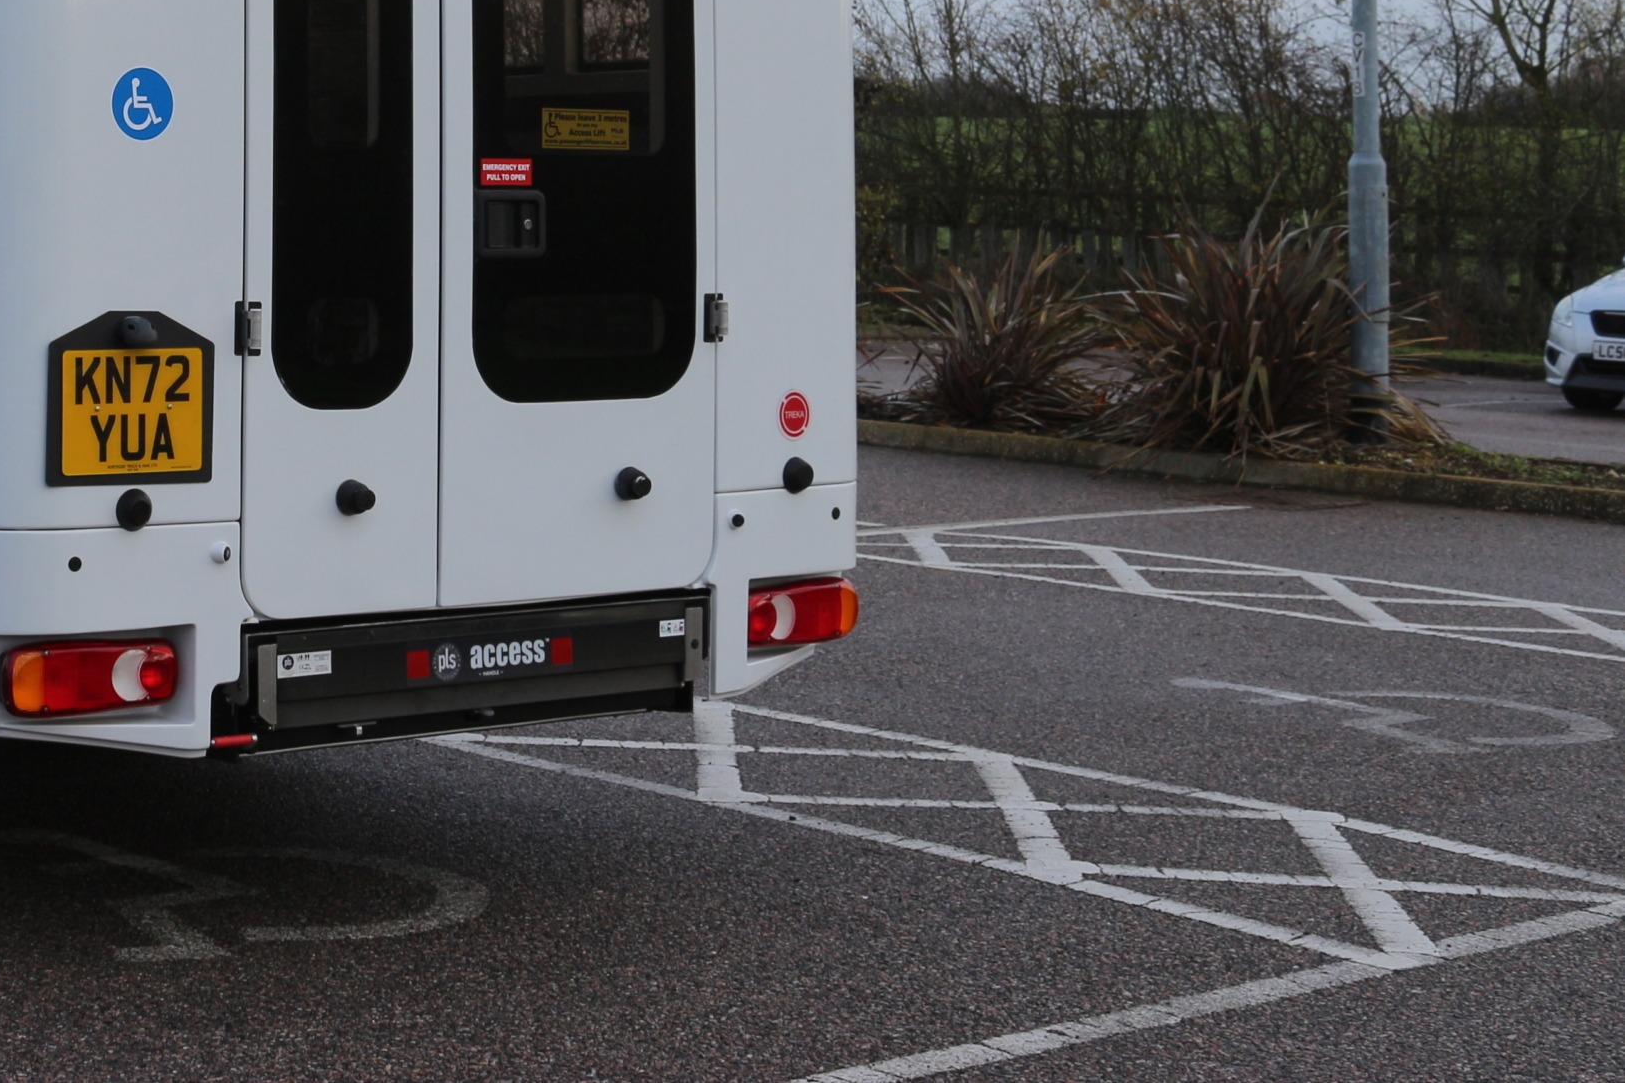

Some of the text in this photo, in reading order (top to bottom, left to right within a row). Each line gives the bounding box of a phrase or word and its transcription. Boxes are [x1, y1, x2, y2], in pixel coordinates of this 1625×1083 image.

[554, 112, 627, 123] Please leave 3 metres
[569, 129, 606, 137] Access Lift
[1598, 345, 1625, 359] LC5
[75, 355, 190, 405] KN72
[785, 410, 805, 419] TREKA
[90, 413, 175, 462] YUA
[438, 647, 457, 673] pls
[470, 638, 546, 670] access
